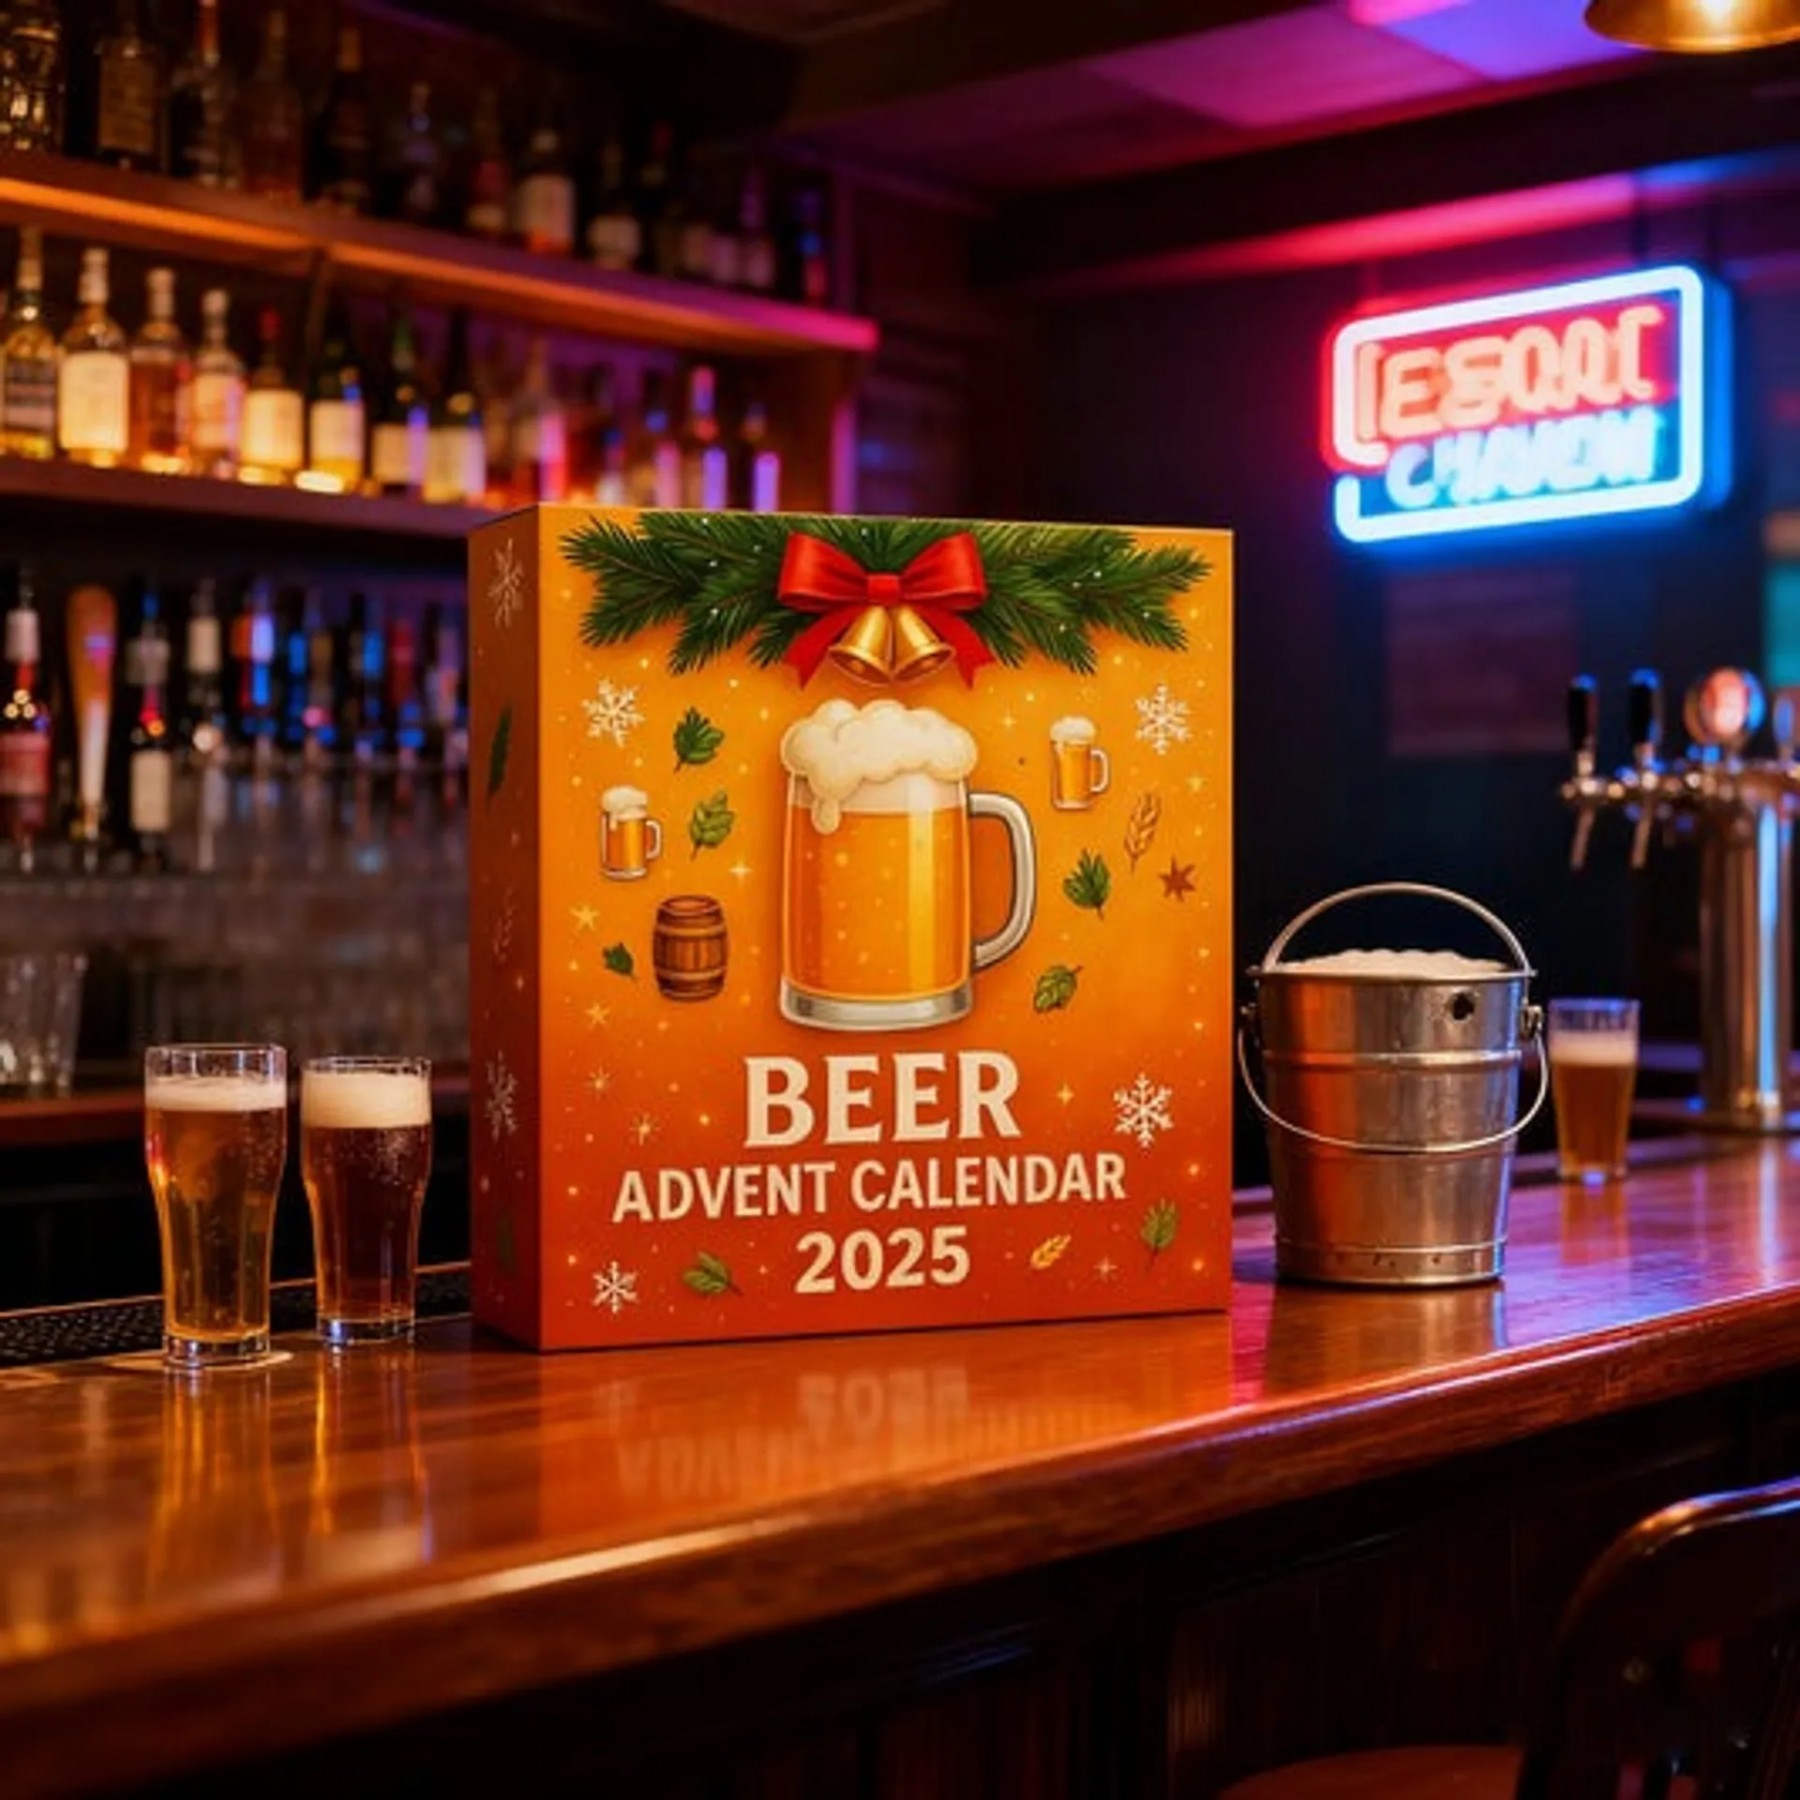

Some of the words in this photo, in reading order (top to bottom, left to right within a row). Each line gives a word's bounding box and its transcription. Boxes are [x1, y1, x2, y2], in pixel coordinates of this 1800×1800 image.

[745, 1051, 1021, 1147] BEER
[613, 1163, 836, 1222] ADVENT
[852, 1154, 1125, 1211] CALENDAR
[797, 1227, 969, 1293] 2025
